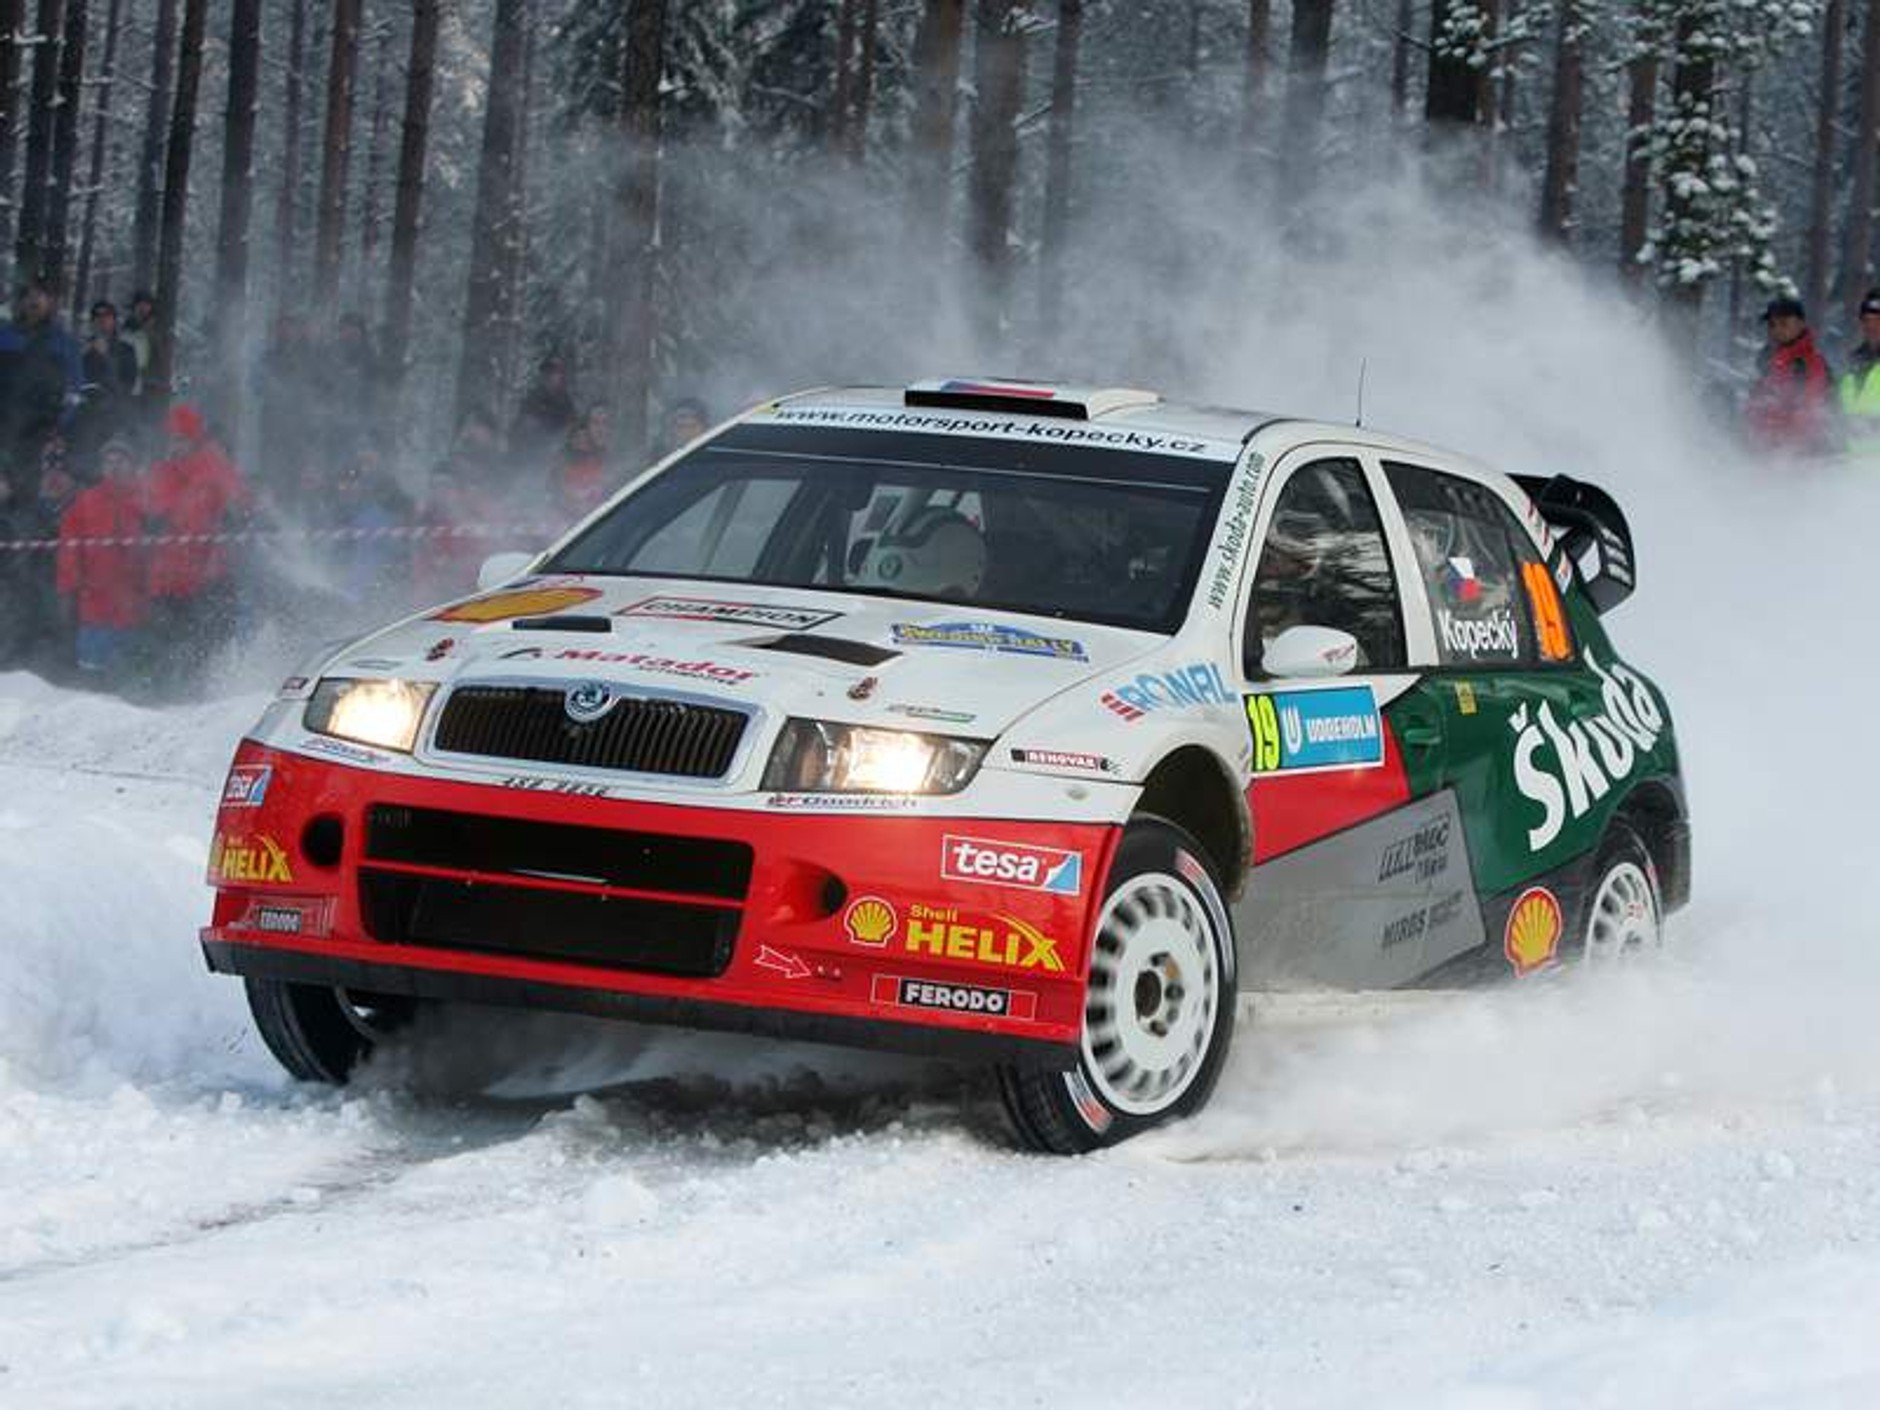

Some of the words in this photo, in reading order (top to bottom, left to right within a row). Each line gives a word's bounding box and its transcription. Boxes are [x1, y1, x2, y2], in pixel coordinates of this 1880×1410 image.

[775, 409, 1206, 452] www.motorsport-kopecky.cz
[644, 601, 818, 623] CHAMPION
[1437, 609, 1519, 660] Kopecký
[554, 649, 752, 680] Matador
[1114, 662, 1237, 711] RONAL
[1247, 693, 1279, 771] 19
[1508, 643, 1664, 852] Škoda
[221, 833, 294, 882] HELIX
[953, 842, 1039, 882] tesa
[910, 904, 958, 922] Shell
[905, 911, 1065, 971] HELIX
[904, 982, 1005, 1013] FERODO
